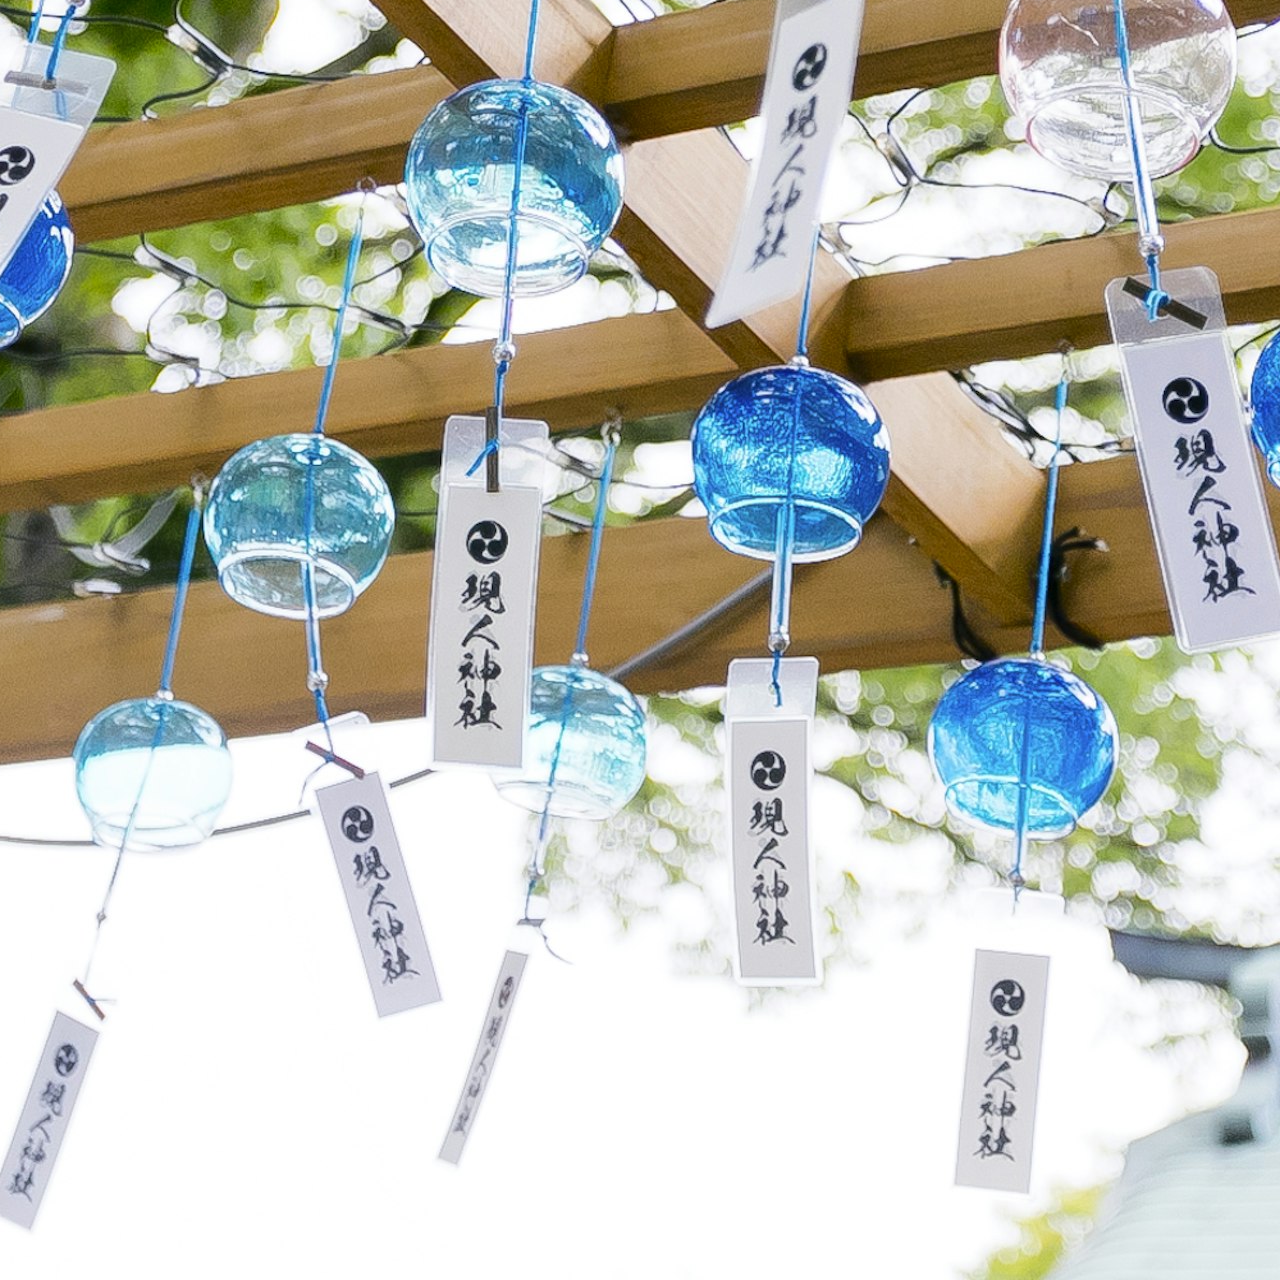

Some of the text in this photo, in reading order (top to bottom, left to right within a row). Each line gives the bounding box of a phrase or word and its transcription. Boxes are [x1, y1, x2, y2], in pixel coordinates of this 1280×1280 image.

[749, 97, 818, 273] 現人神社
[1174, 429, 1256, 603] 現人神社
[455, 572, 506, 730] 現人神社
[352, 846, 420, 986] 現人神社
[749, 798, 796, 946] 現人神社
[9, 1081, 65, 1202] 現人神社
[973, 1023, 1023, 1162] 現人神社
